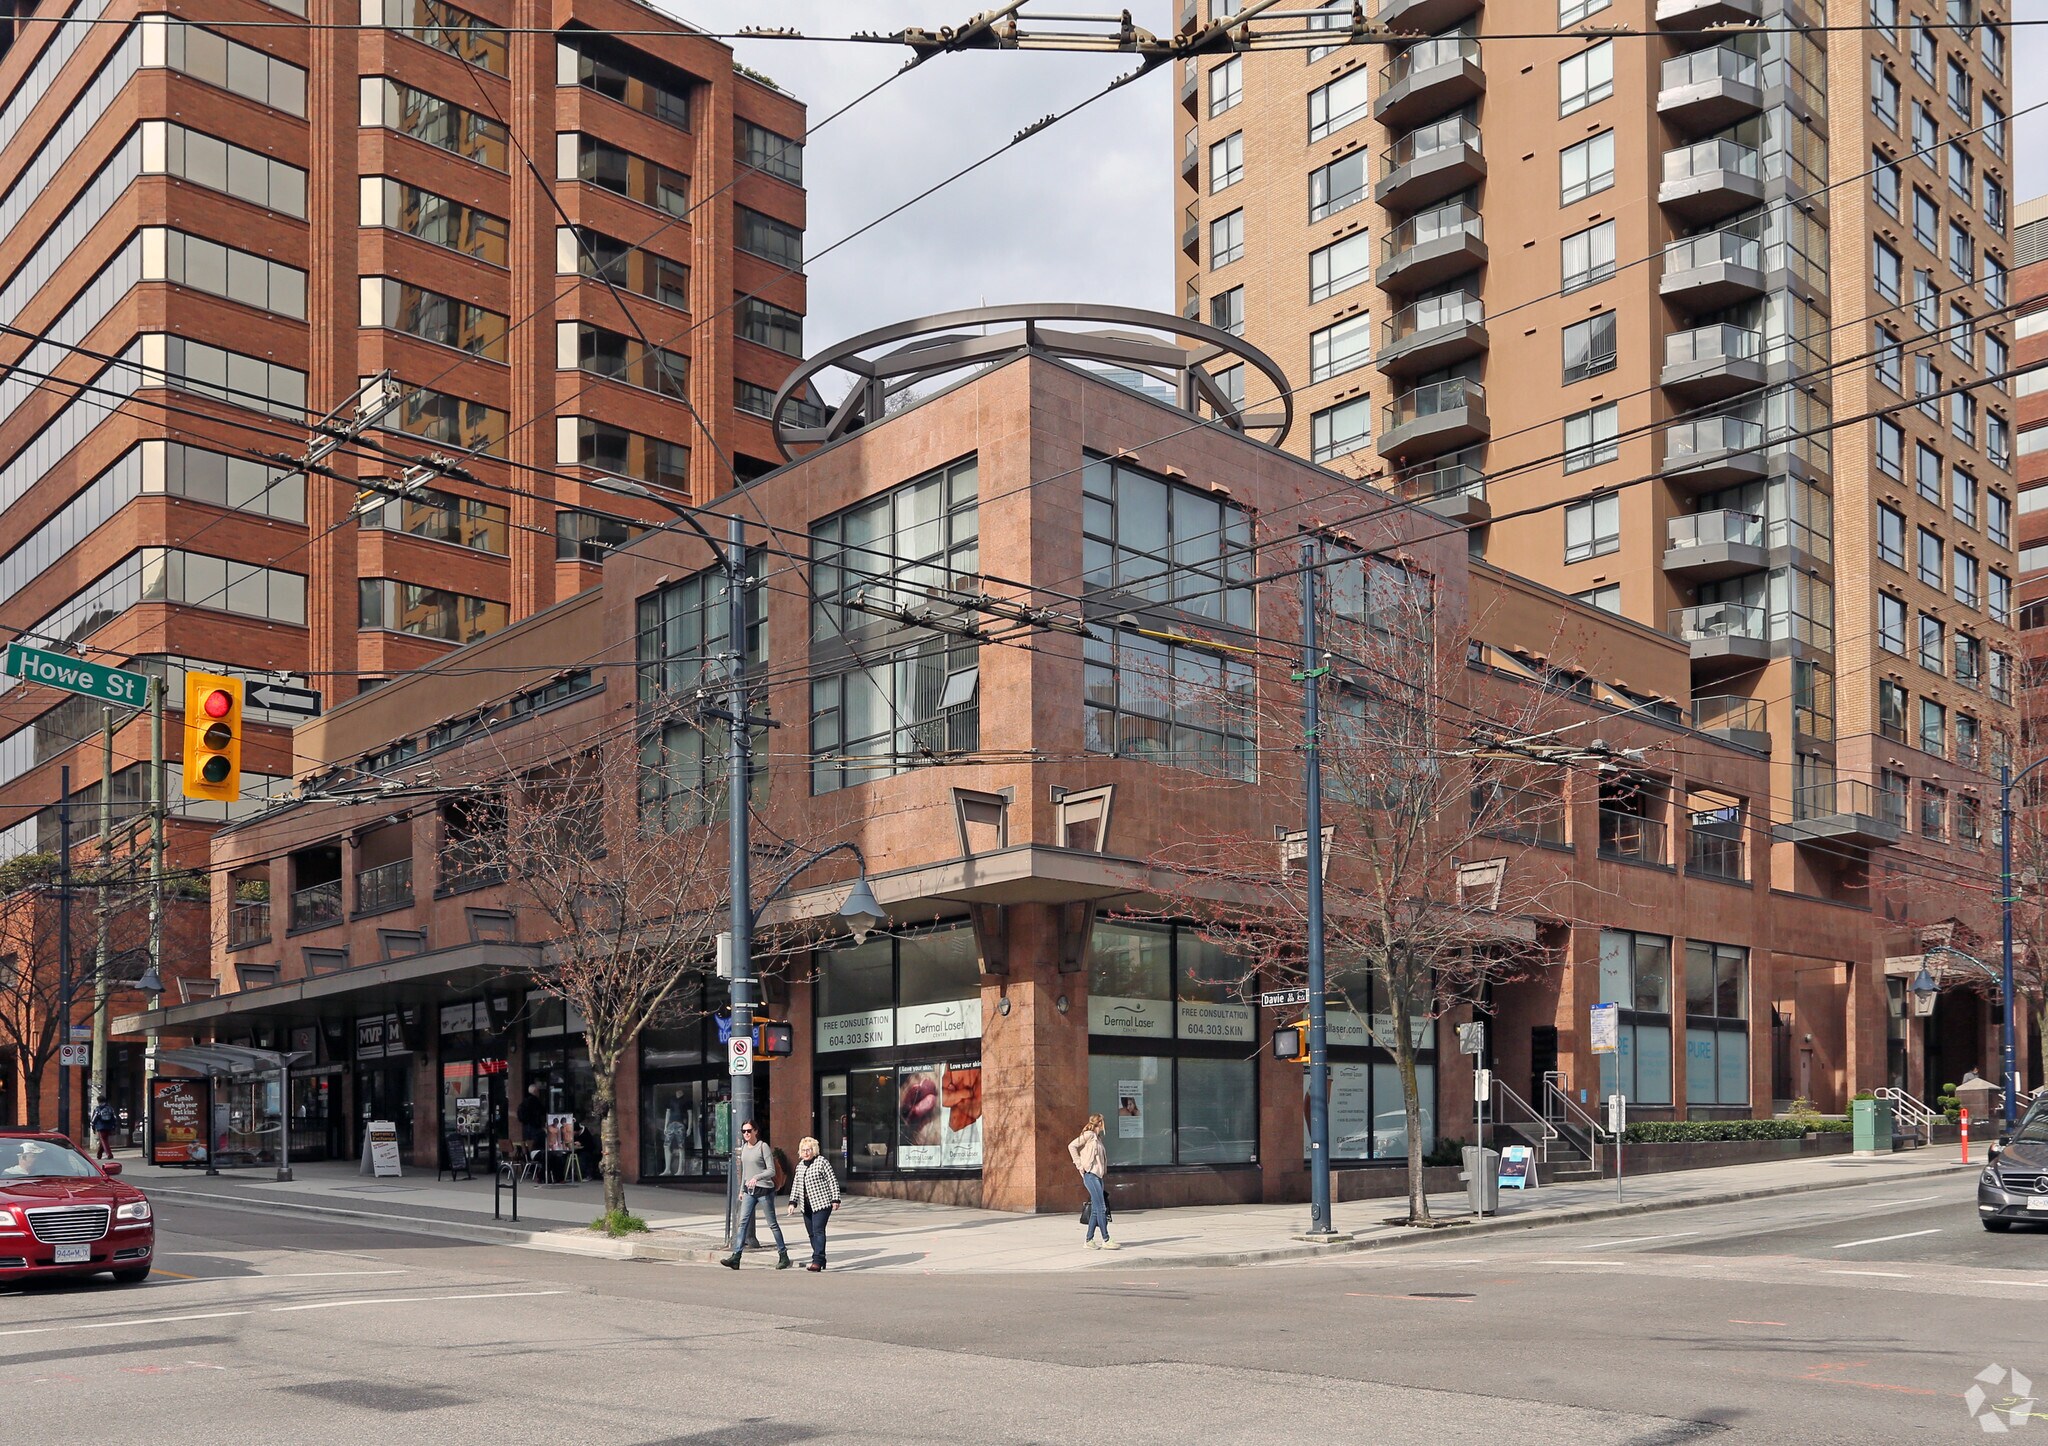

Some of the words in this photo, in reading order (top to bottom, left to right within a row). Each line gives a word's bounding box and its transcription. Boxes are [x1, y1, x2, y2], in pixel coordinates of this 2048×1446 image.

[20, 651, 94, 689] Howe
[106, 673, 135, 700] St
[1264, 993, 1284, 1005] Davie
[1104, 1014, 1133, 1027] Dermal
[1134, 1017, 1155, 1028] Laser
[1181, 1008, 1197, 1017] FREE
[1199, 1009, 1249, 1020] CONSULTATION
[823, 1021, 839, 1030] FREE
[839, 1015, 889, 1029] CONSULTATION
[915, 1021, 943, 1034] Dermal
[944, 1020, 965, 1032] Laser
[360, 1026, 383, 1044] MVP
[1187, 1023, 1243, 1037] 604.303.SKIN
[829, 1031, 883, 1047] 604.303.SKIN
[1687, 1041, 1711, 1059] PURE
[950, 1062, 961, 1070] Love
[961, 1062, 972, 1070] your
[163, 1101, 185, 1109] through
